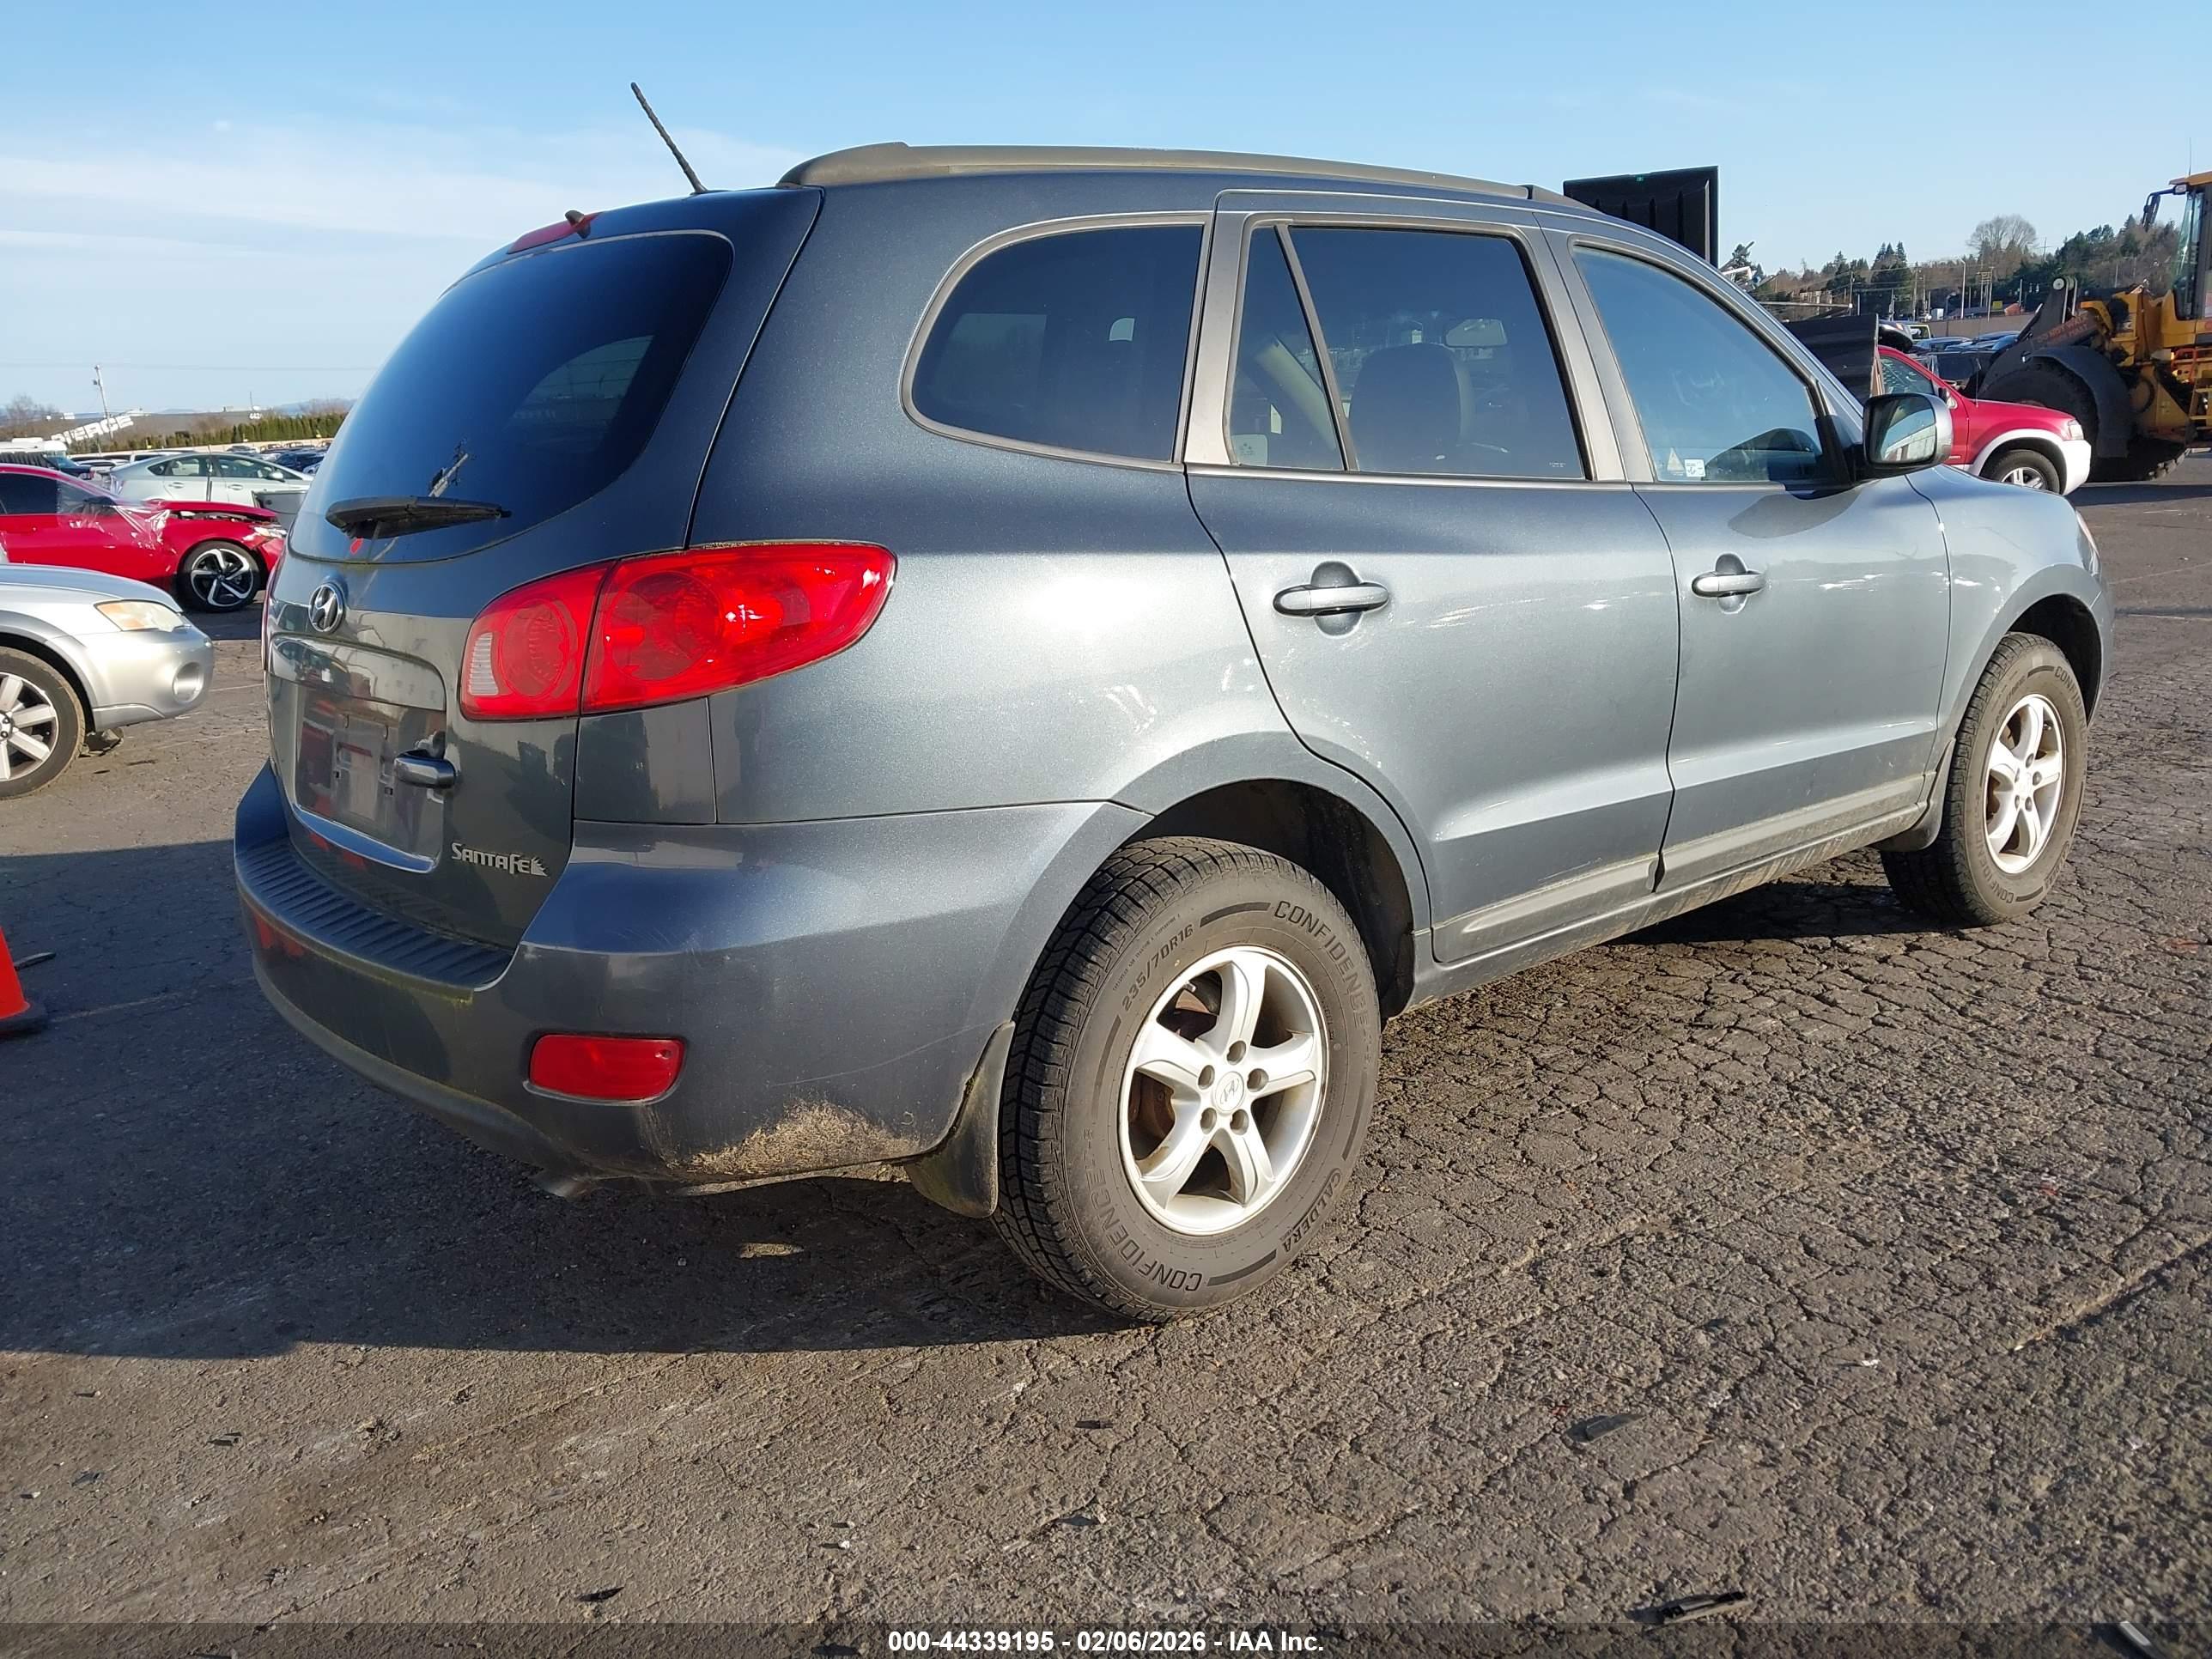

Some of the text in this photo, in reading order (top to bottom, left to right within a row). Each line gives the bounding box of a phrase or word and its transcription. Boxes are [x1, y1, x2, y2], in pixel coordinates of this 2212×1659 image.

[1121, 924, 1194, 1012] 235/70R16
[1274, 900, 1370, 1029] CONFIDENCE
[1085, 1168, 1203, 1292] CONFIDENCE
